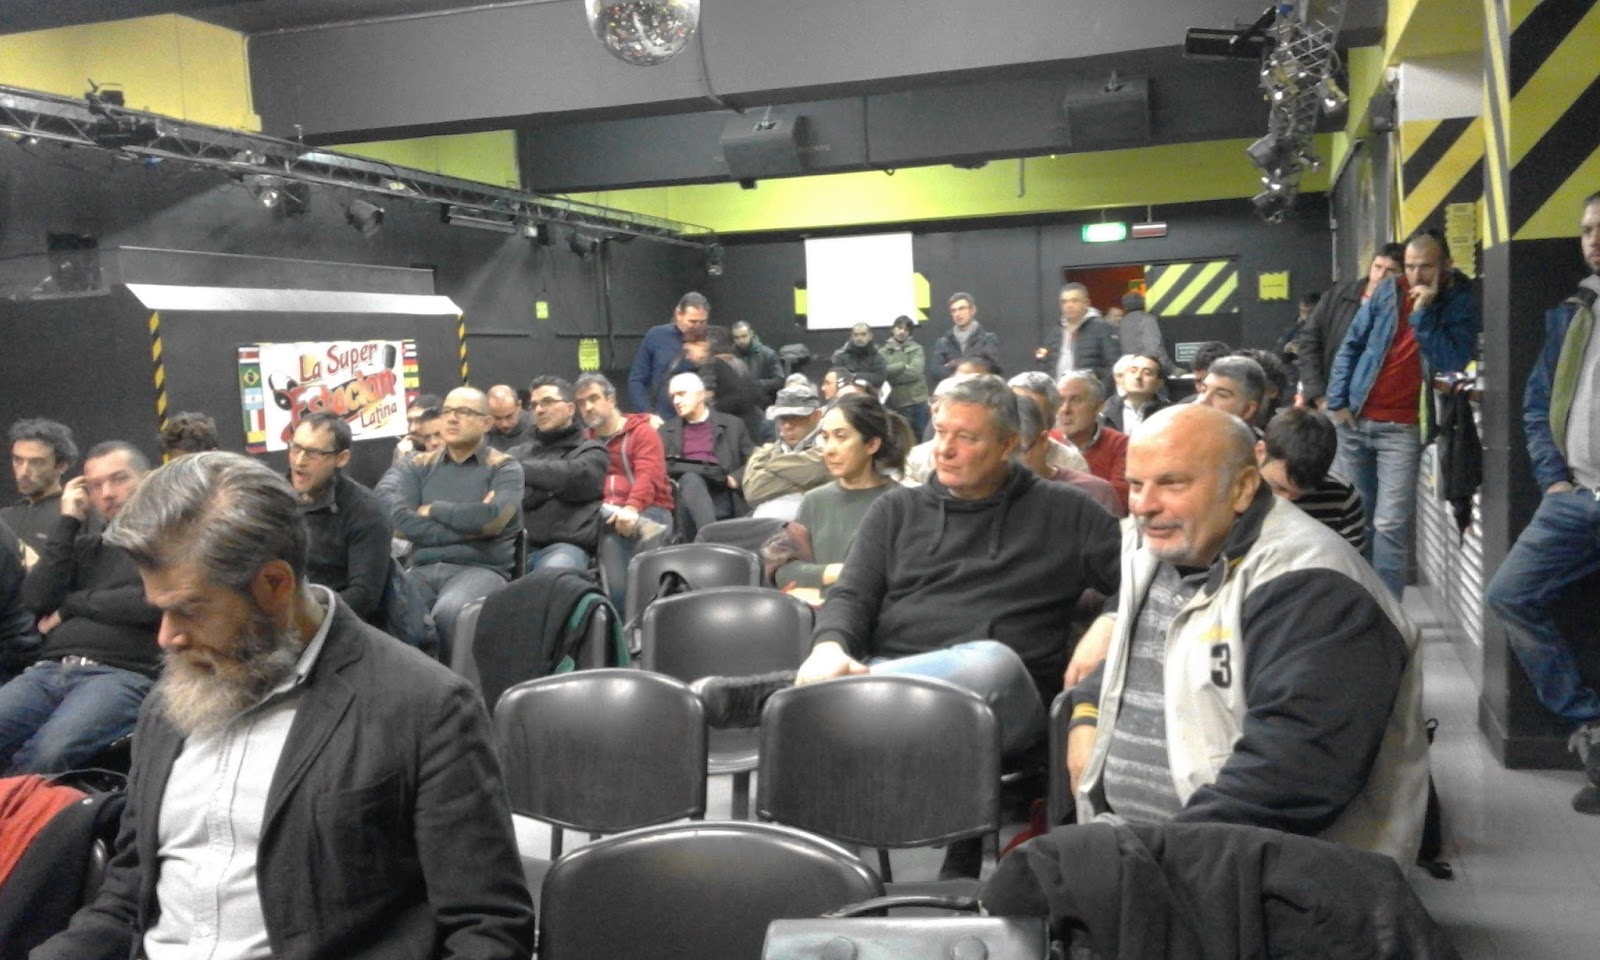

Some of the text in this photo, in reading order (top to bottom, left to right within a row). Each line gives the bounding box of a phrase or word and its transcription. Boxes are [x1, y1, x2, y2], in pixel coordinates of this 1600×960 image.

[299, 343, 379, 382] La Super
[360, 402, 398, 428] Latina
[1210, 642, 1232, 689] 3
